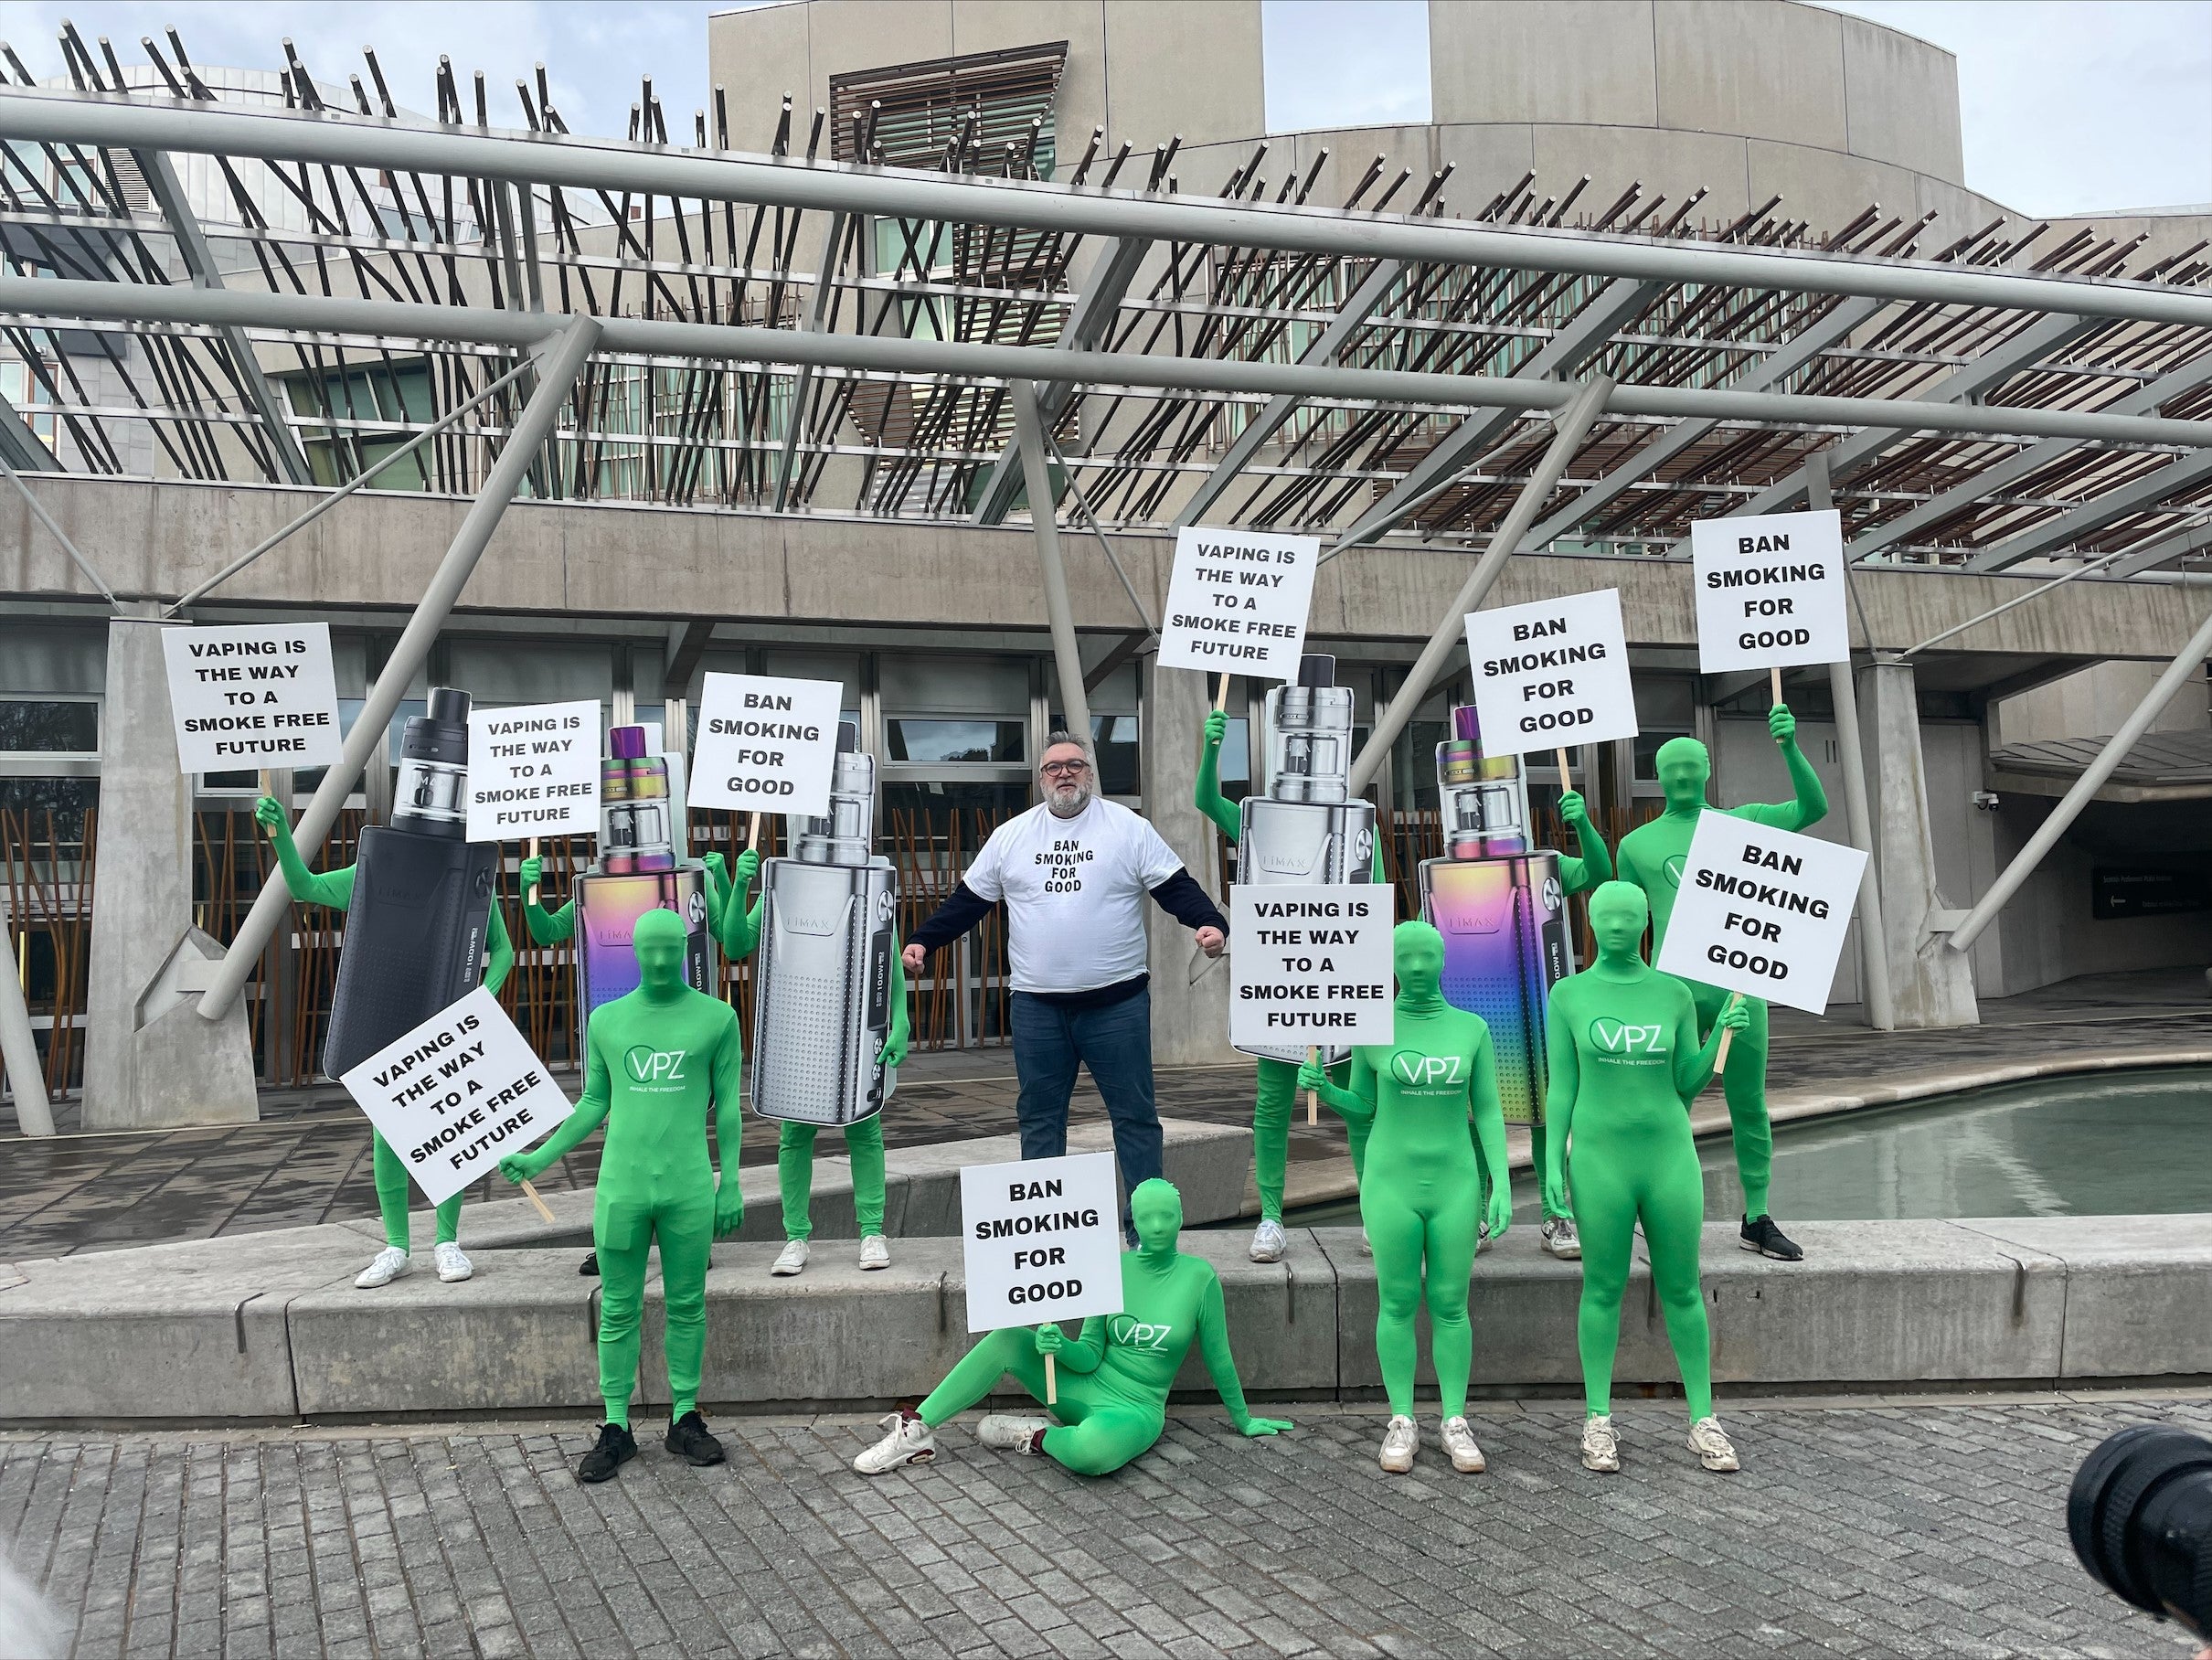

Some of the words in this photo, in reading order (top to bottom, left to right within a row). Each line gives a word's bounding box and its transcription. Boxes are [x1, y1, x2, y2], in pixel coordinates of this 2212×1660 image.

[1197, 543, 1270, 562] VAPING
[1276, 550, 1295, 565] IS
[1739, 534, 1790, 555] BAN
[1195, 568, 1234, 583] THE
[1239, 571, 1284, 588] WAY
[1707, 563, 1825, 589] SMOKING
[1212, 593, 1238, 608] TO
[1243, 597, 1257, 611] A
[1744, 598, 1794, 618] FOR
[1172, 614, 1241, 633] SMOKE
[1246, 622, 1297, 639] FREE
[1513, 617, 1567, 642] BAN
[188, 641, 278, 657] VAPING
[284, 640, 306, 654] IS
[1739, 628, 1810, 650] GOOD
[1190, 640, 1269, 661] FUTURE
[1484, 643, 1606, 677] SMOKING
[195, 667, 242, 682] THE
[248, 665, 299, 680] WAY
[223, 691, 256, 706] TO
[263, 690, 279, 704] A
[1523, 679, 1575, 702] FOR
[743, 693, 792, 711] BAN
[185, 715, 267, 732] SMOKE
[272, 712, 330, 728] FREE
[488, 718, 557, 735] VAPING
[563, 717, 580, 729] IS
[708, 718, 820, 741] SMOKING
[1519, 708, 1594, 733] GOOD
[215, 738, 306, 756] FUTURE
[490, 743, 526, 758] THE
[531, 740, 572, 754] WAY
[738, 749, 784, 767] FOR
[509, 765, 535, 778] TO
[540, 763, 553, 776] A
[475, 787, 540, 803] SMOKE
[547, 782, 592, 798] FREE
[727, 777, 794, 795] GOOD
[496, 807, 569, 825] FUTURE
[1053, 839, 1079, 852] BAN
[1035, 850, 1094, 867] SMOKING
[1741, 844, 1803, 876] BAN
[1051, 867, 1077, 879] FOR
[1044, 879, 1082, 893] GOOD
[1696, 868, 1830, 920] SMOKING
[1254, 902, 1340, 918] VAPING
[1348, 902, 1369, 917] IS
[1257, 930, 1302, 945] THE
[1308, 930, 1360, 945] WAY
[1724, 911, 1781, 943] FOR
[1281, 957, 1313, 973] TO
[1319, 957, 1335, 973] A
[1707, 944, 1789, 980] GOOD
[1239, 984, 1320, 1000] SMOKE
[1327, 984, 1384, 1000] FREE
[1267, 1012, 1357, 1027] FUTURE
[1597, 1021, 1667, 1053] VPZ
[372, 1032, 456, 1088] VAPING
[455, 1015, 480, 1036] IS
[1598, 1057, 1622, 1065] INHALE
[391, 1074, 439, 1108] THE
[437, 1040, 484, 1079] WAY
[630, 1049, 686, 1080] VPZ
[1398, 1056, 1464, 1085] VPZ
[430, 1091, 462, 1115] TO
[466, 1080, 484, 1096] A
[409, 1107, 486, 1164] SMOKE
[485, 1070, 541, 1113] FREE
[449, 1108, 534, 1170] FUTURE
[1009, 1178, 1062, 1202] BAN
[975, 1208, 1099, 1240] SMOKING
[1014, 1247, 1066, 1271] FOR
[1008, 1279, 1083, 1305] GOOD
[1114, 1319, 1172, 1352] VPZ
